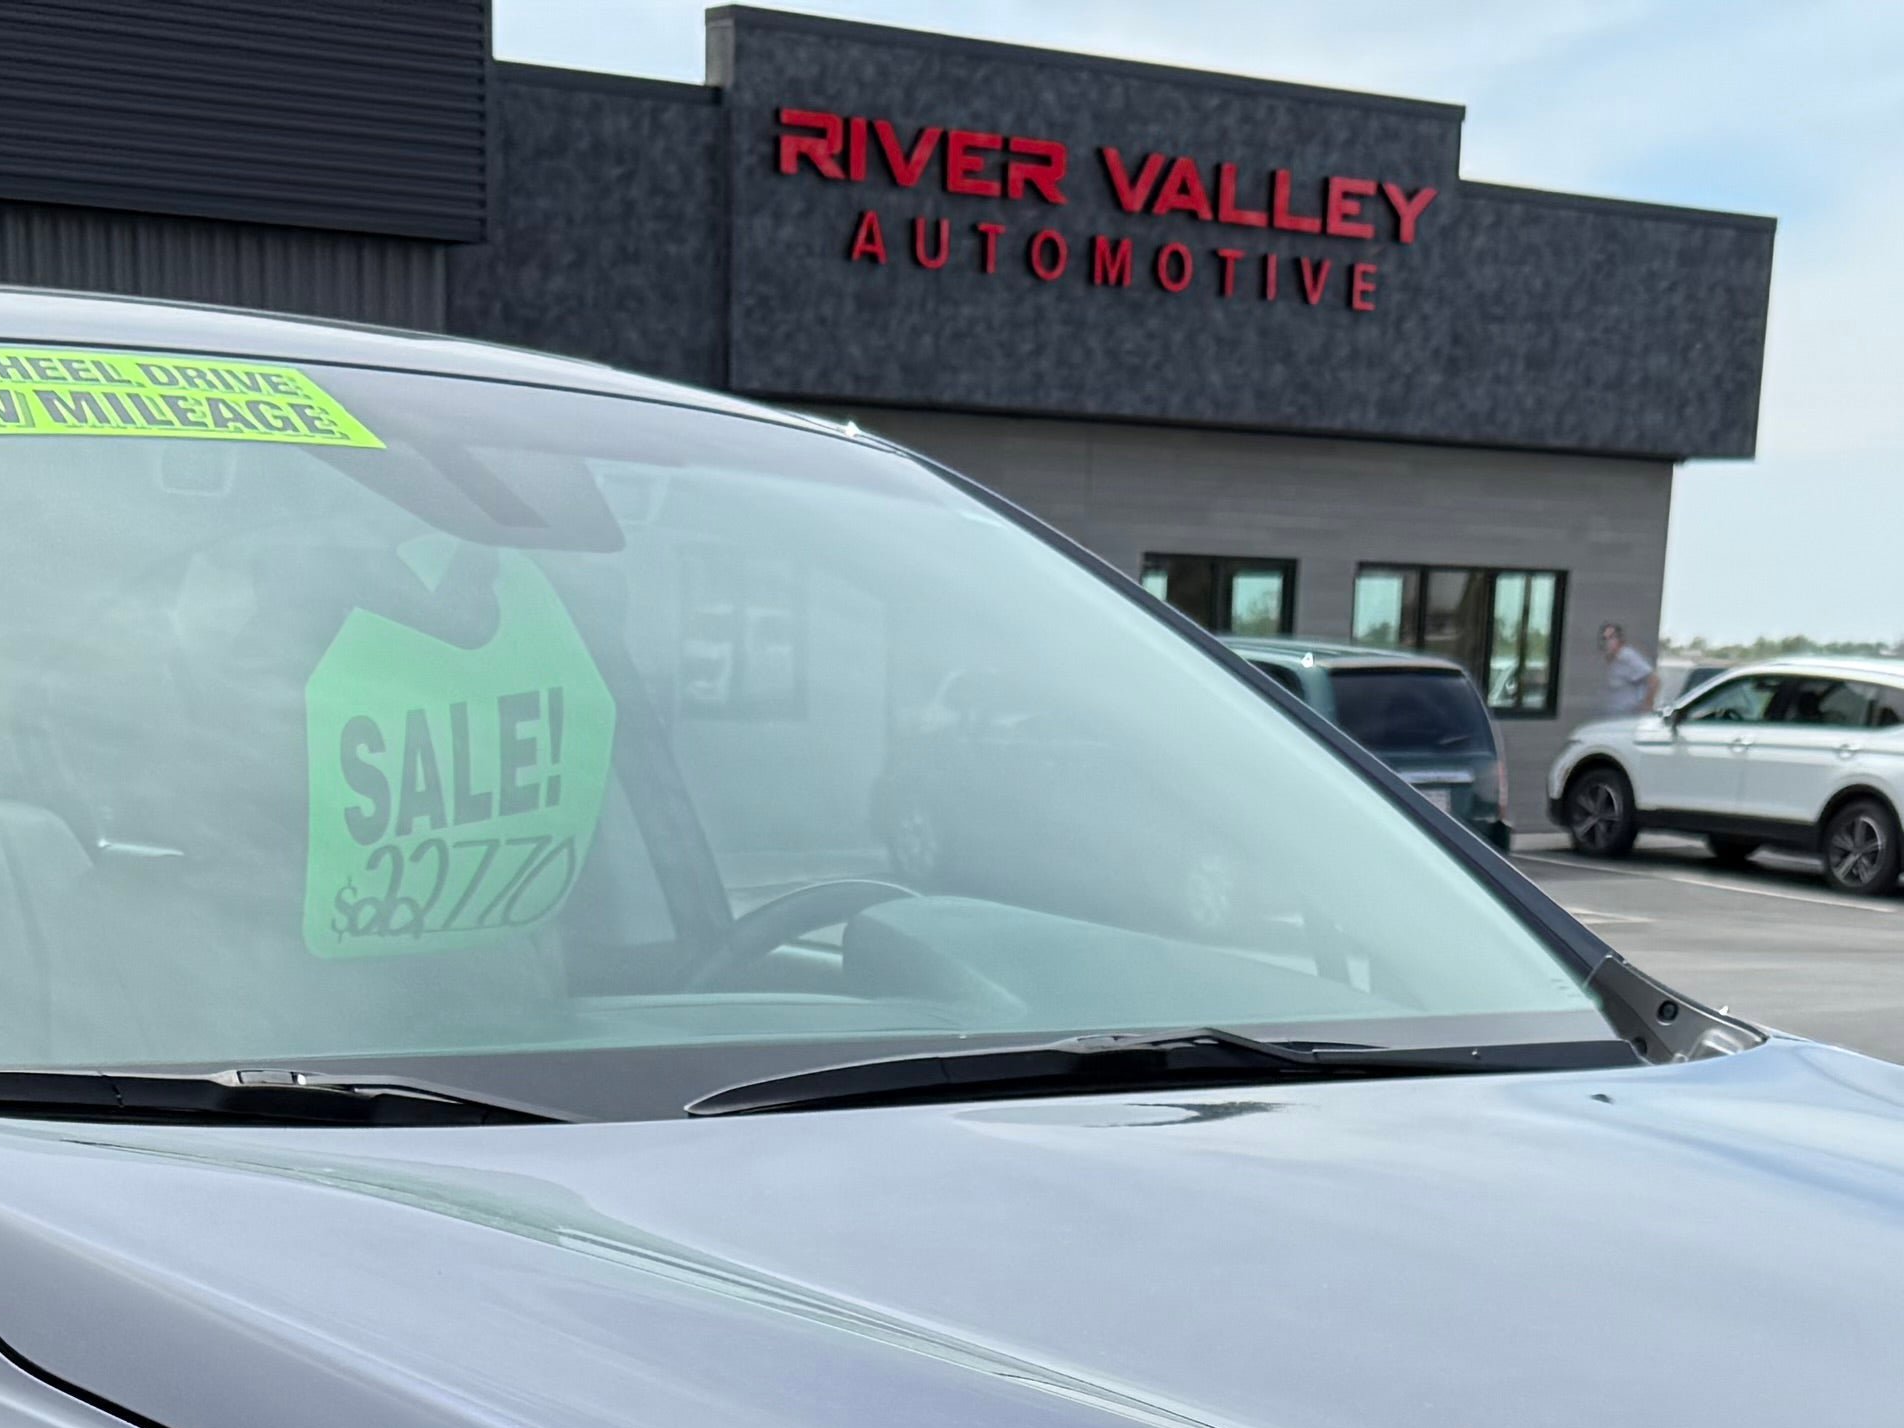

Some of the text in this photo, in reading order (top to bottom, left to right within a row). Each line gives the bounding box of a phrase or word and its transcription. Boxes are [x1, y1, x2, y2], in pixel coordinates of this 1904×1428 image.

[777, 107, 1439, 243] RIVER VALLEY
[850, 210, 1377, 311] AUTOMOTIVE
[33, 389, 344, 438] MILEAGE
[137, 363, 306, 397] DRIVE
[339, 686, 564, 846] SALE!
